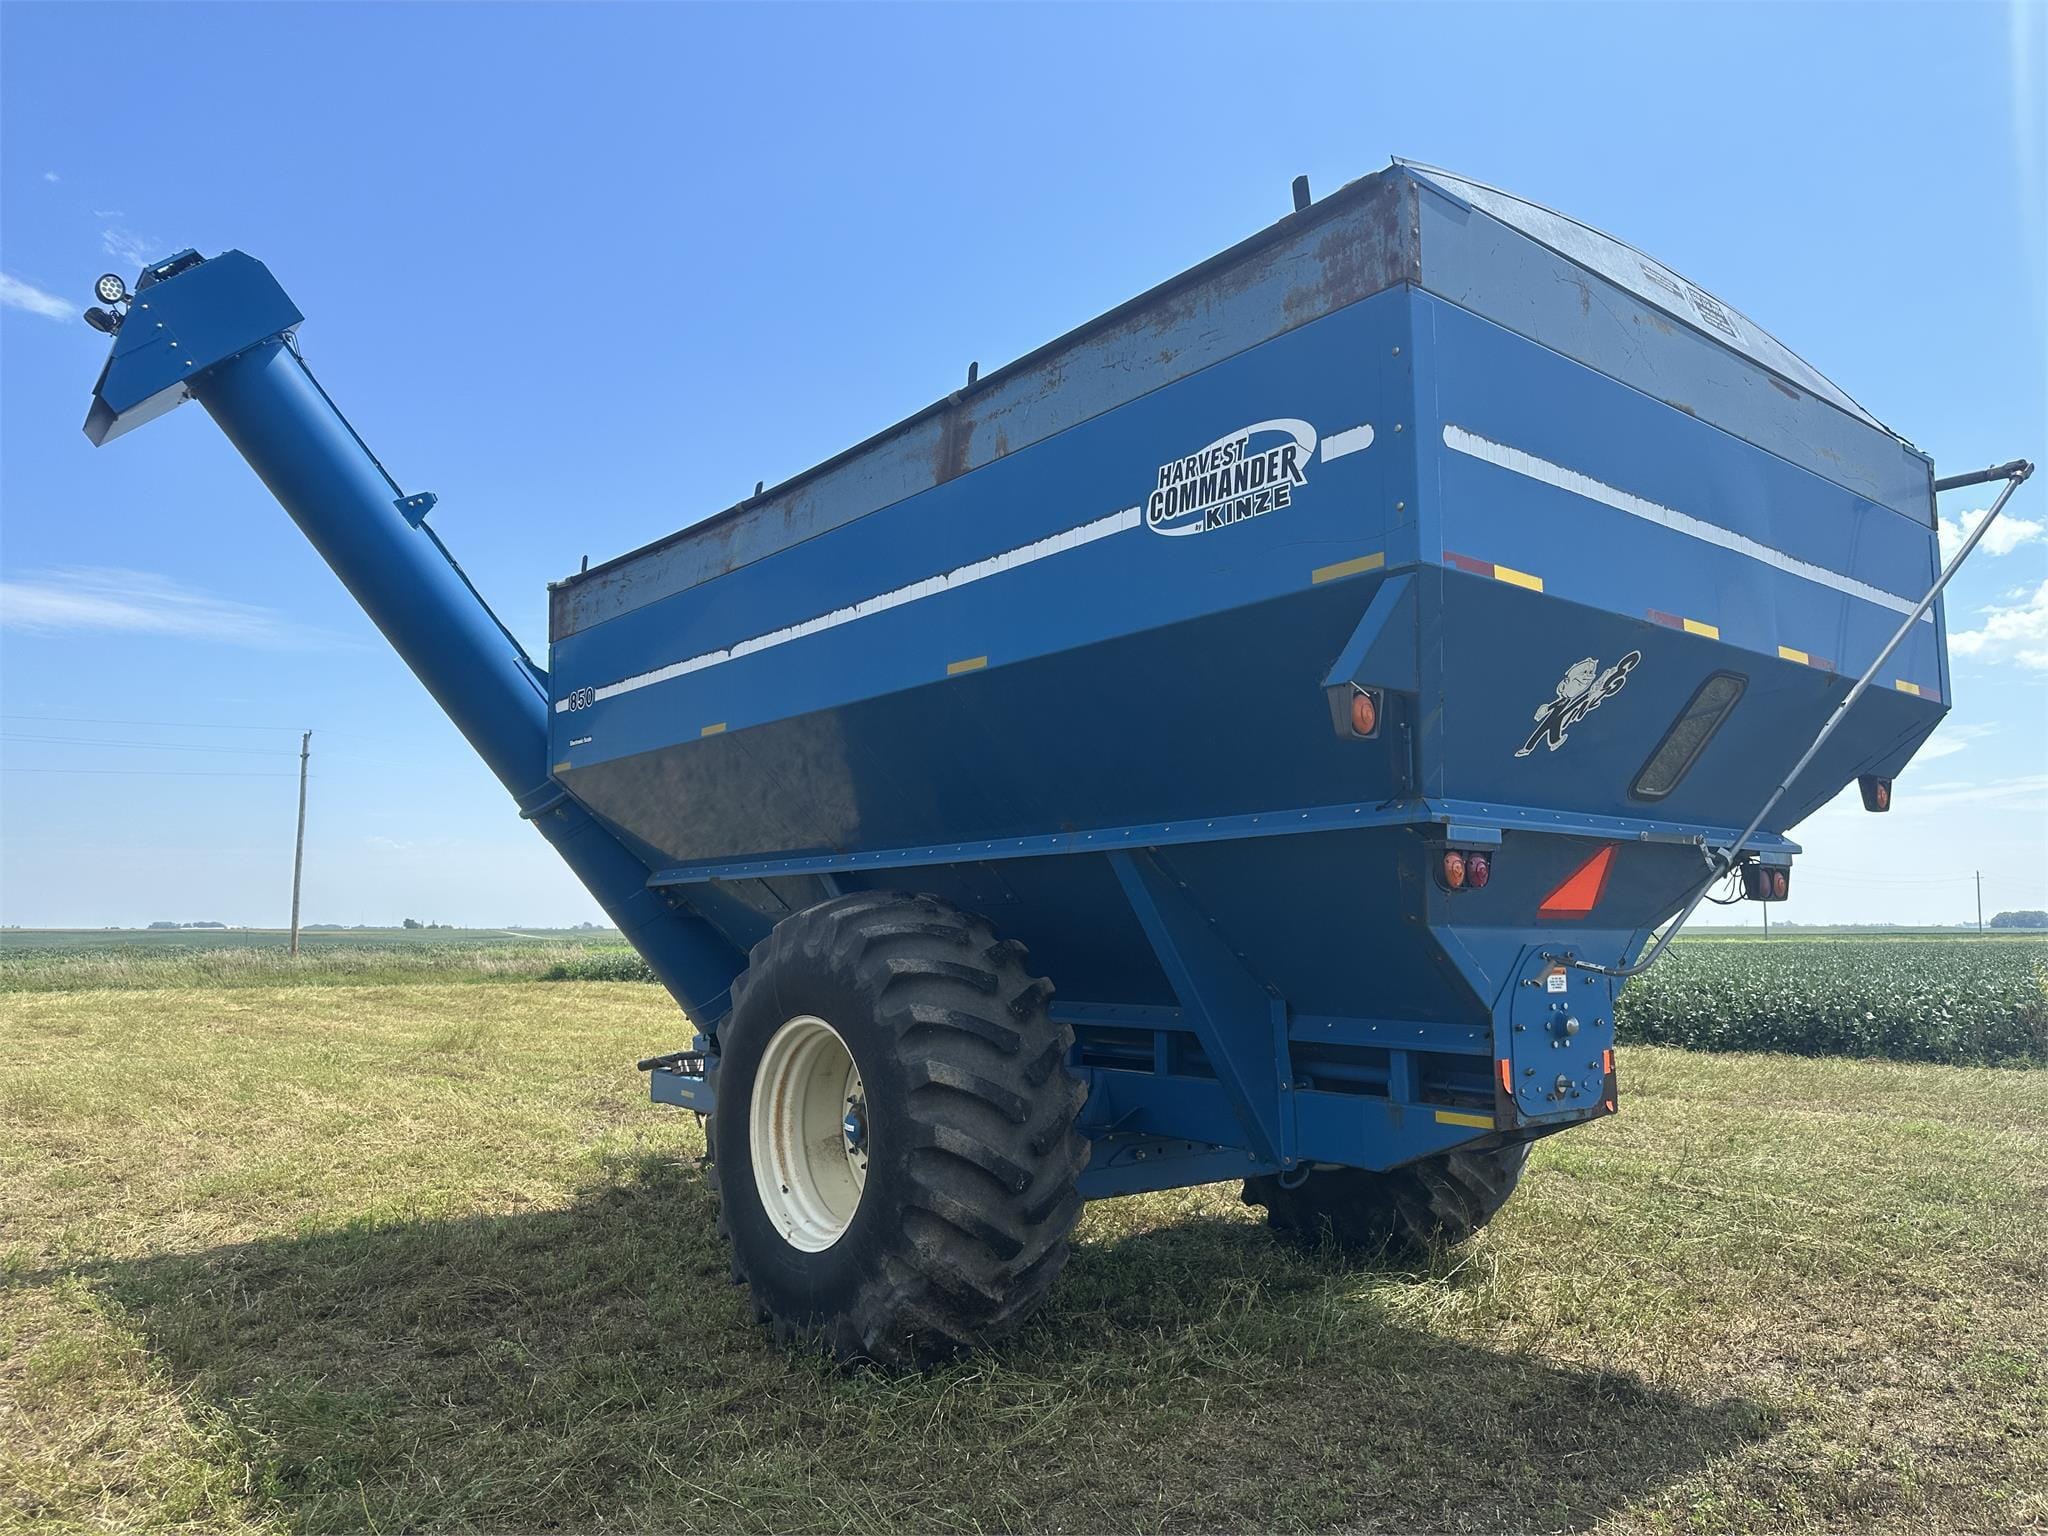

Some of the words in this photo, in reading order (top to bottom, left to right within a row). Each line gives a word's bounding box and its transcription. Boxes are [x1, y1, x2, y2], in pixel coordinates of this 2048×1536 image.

[1150, 444, 1304, 522] COMMANDER
[1159, 436, 1248, 489] HARVEST
[1205, 484, 1291, 531] KINZE
[570, 687, 594, 712] 850
